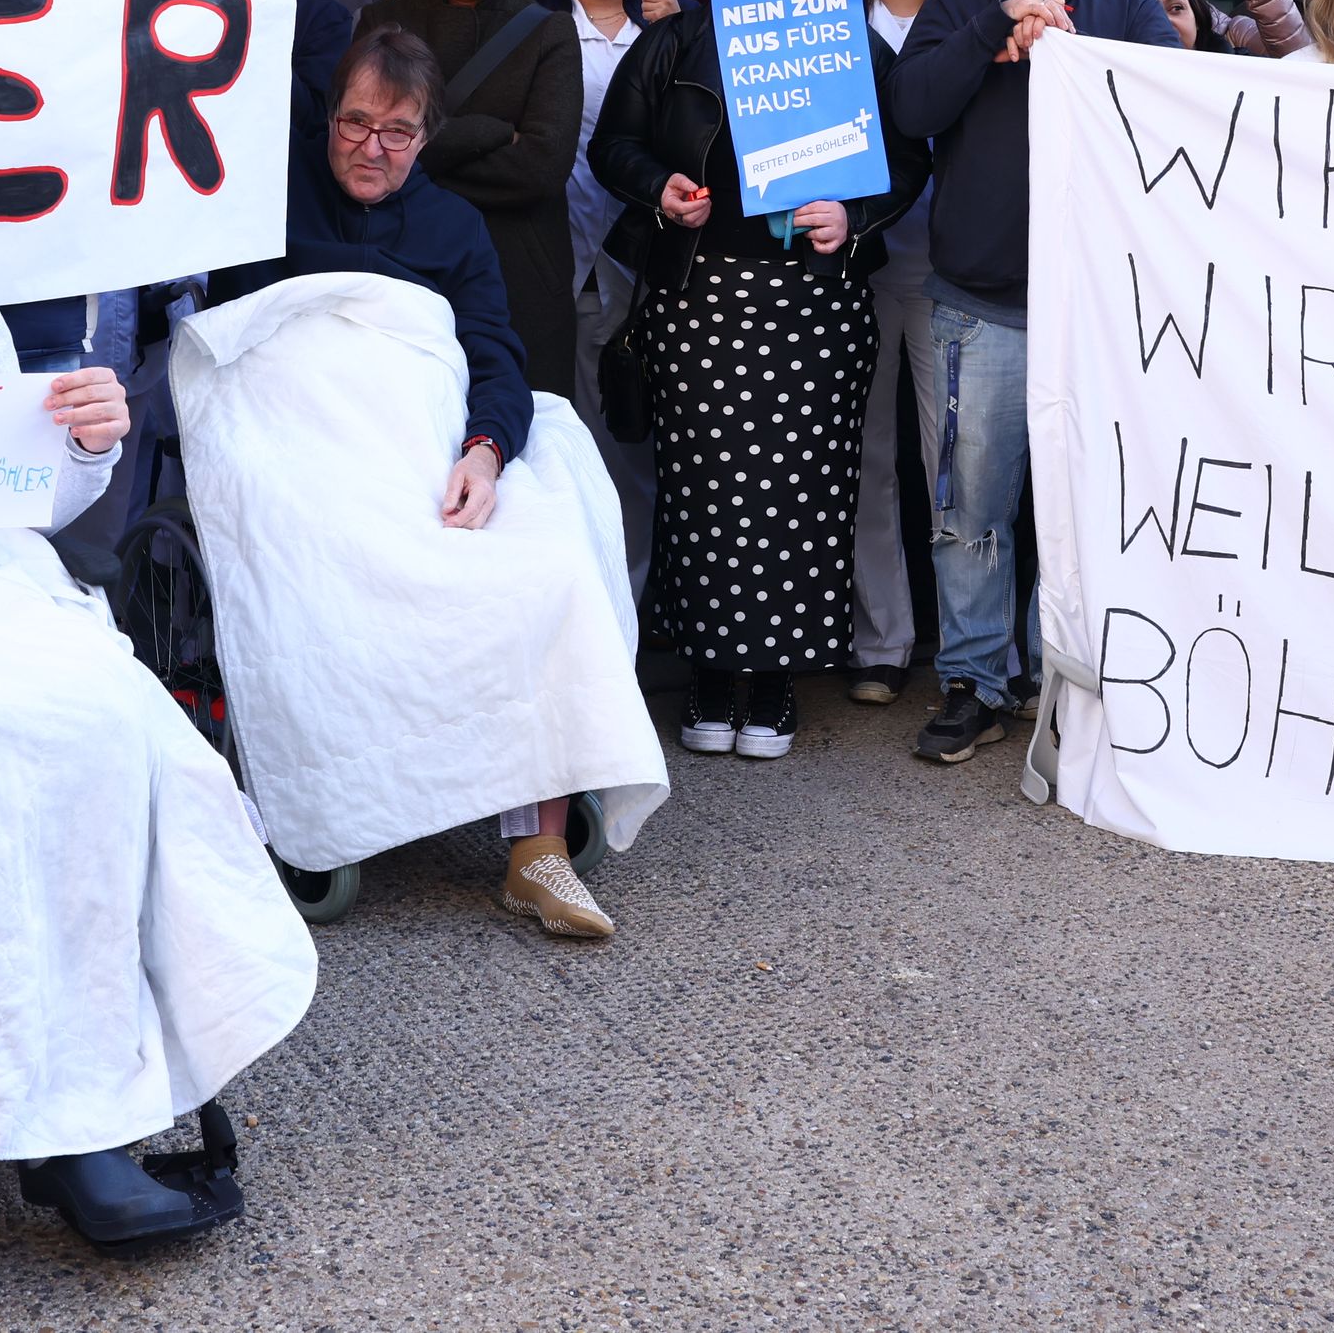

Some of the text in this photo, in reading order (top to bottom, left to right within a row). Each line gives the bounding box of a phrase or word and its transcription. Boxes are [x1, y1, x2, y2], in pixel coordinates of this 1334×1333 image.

[722, 0, 785, 27] NEIN
[727, 21, 851, 58] AUS FÜRS
[731, 50, 861, 87] KRANKEN-
[736, 88, 812, 117] HAUS!
[753, 132, 859, 174] RETTET DAS BÖHLER!
